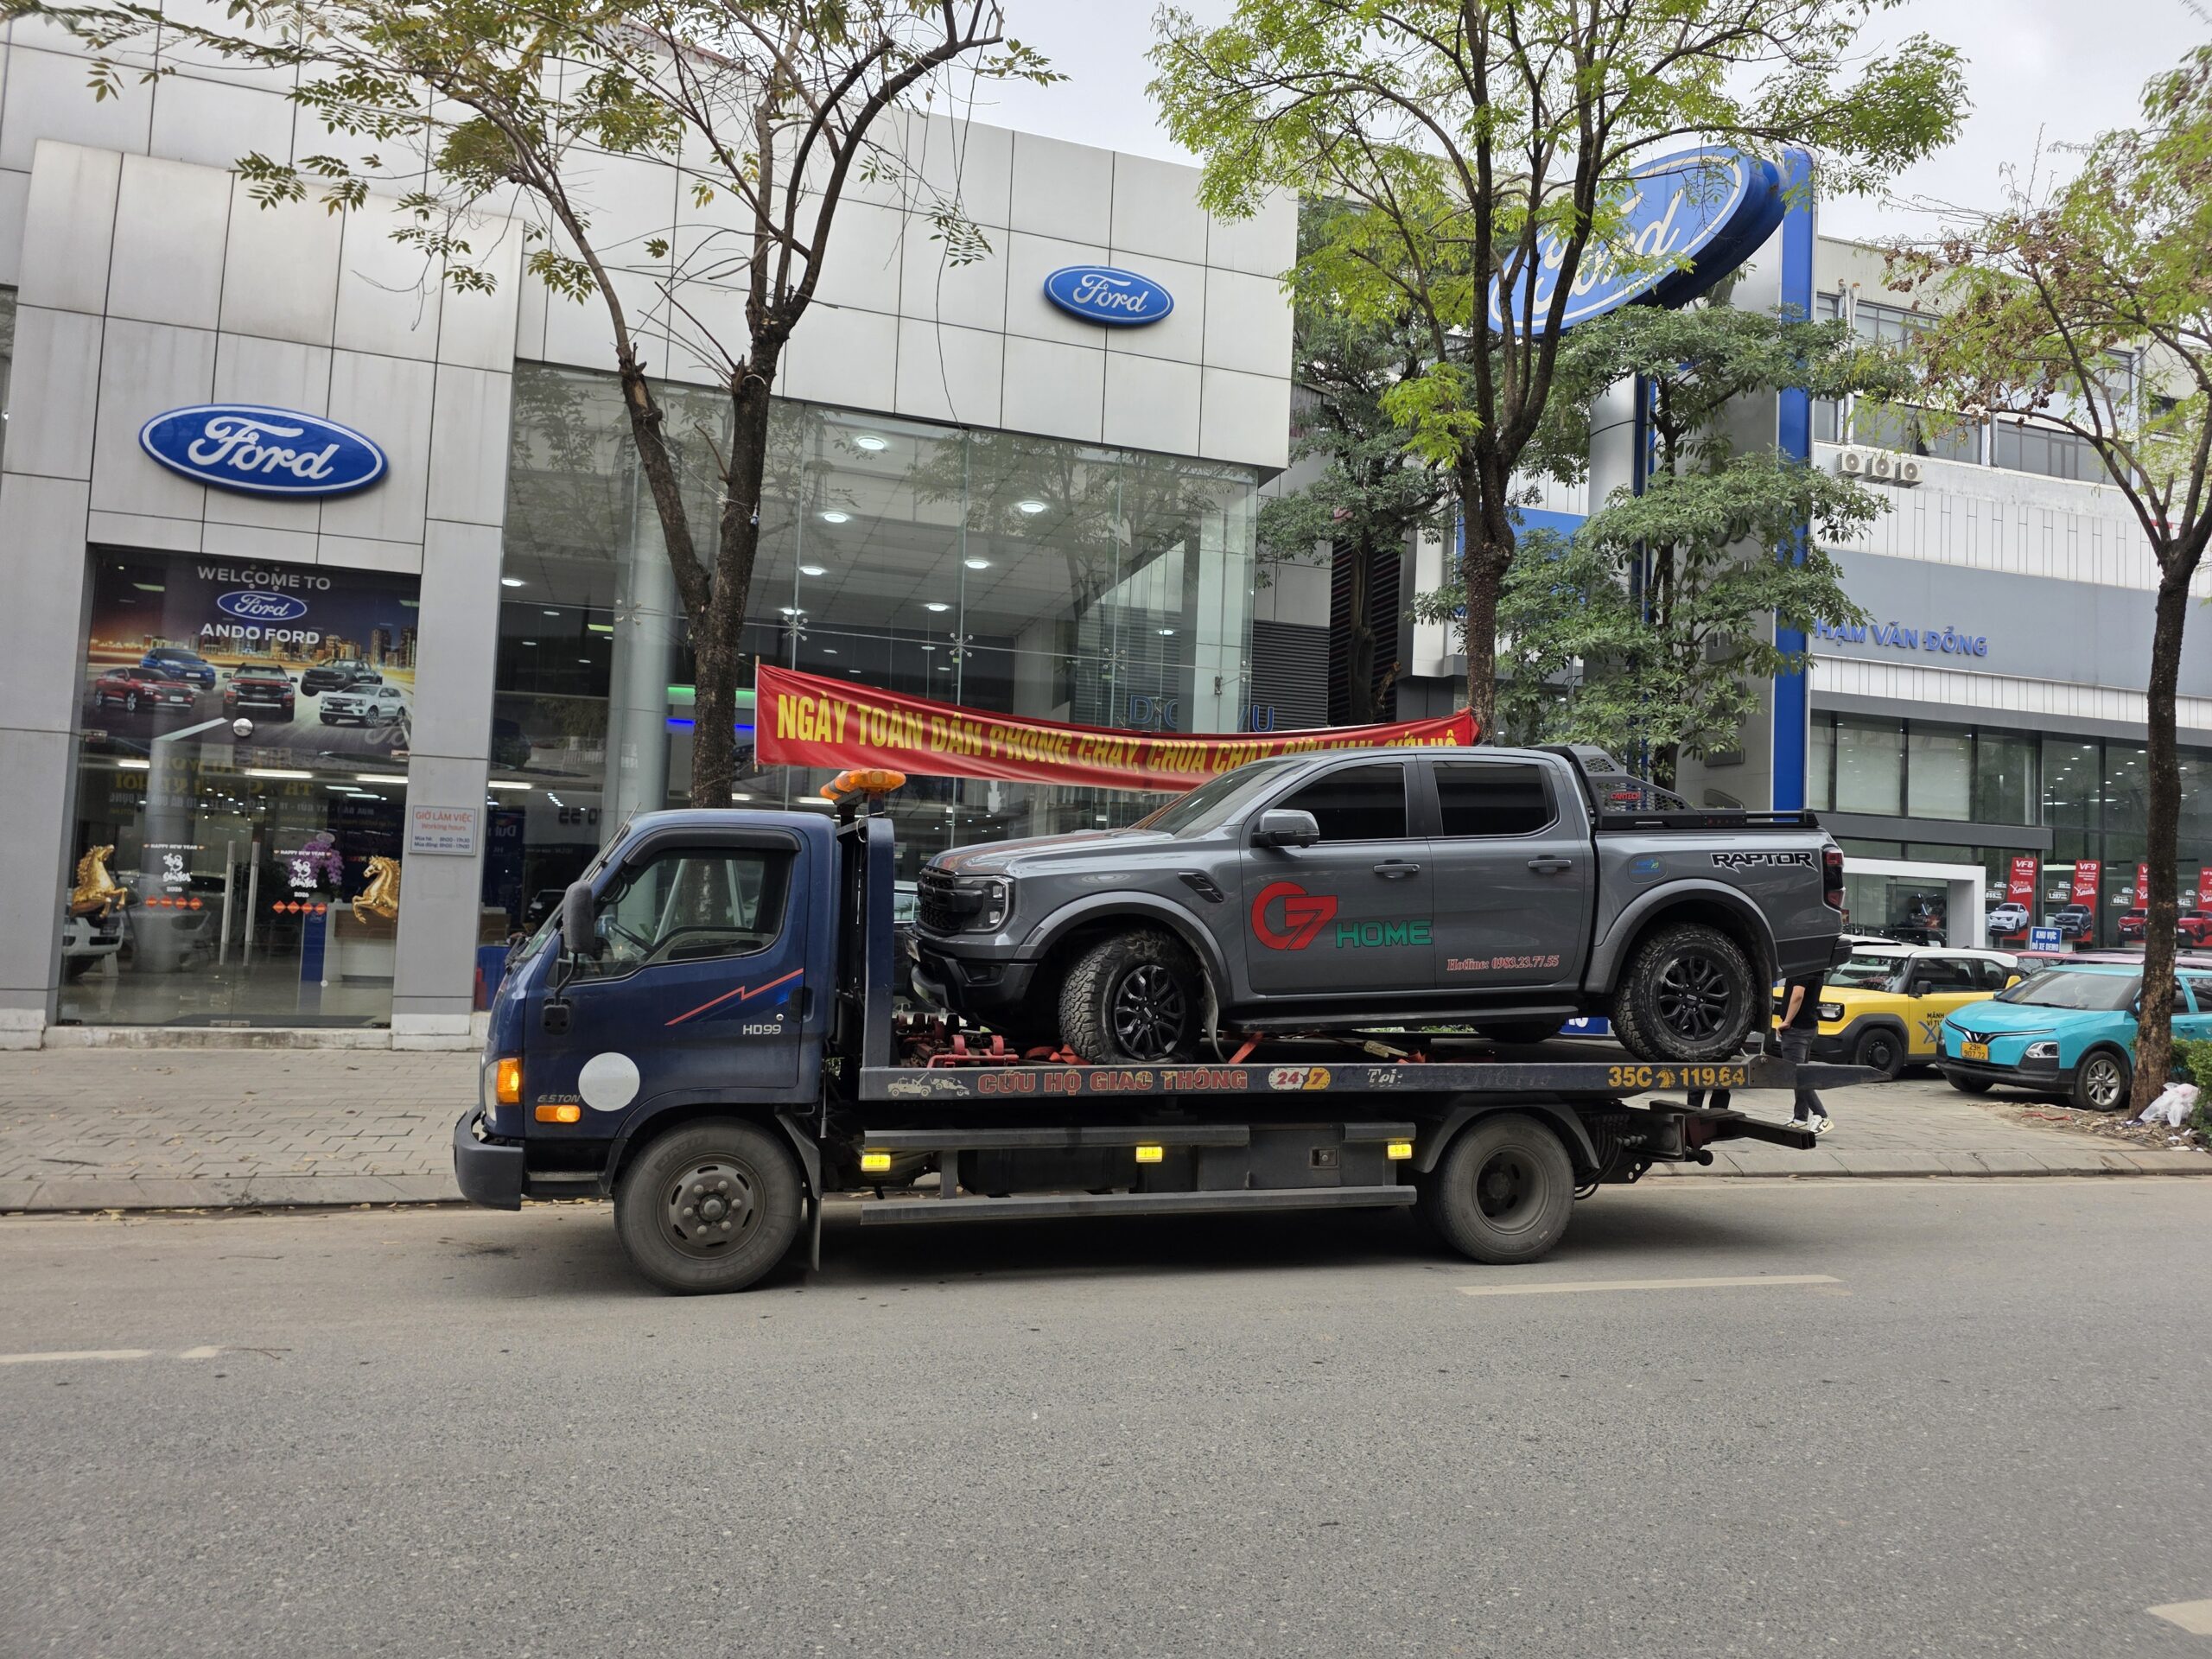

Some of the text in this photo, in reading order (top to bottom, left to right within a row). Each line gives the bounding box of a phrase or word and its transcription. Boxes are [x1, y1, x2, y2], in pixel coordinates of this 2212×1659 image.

[1073, 274, 1148, 312] Ford
[188, 416, 340, 480] Ford
[197, 566, 331, 590] WELCOME TO
[234, 594, 290, 617] Ford
[200, 623, 320, 645] ANDO FORD
[1872, 621, 1918, 649] VĂN
[777, 690, 849, 744] NGÀY
[856, 702, 924, 751] TOÀN
[931, 712, 983, 756] DÂN
[416, 810, 473, 823] GIỜ LÀM VIỆC
[422, 823, 447, 831] Working
[1710, 851, 1819, 874] RAPTOR
[1335, 919, 1433, 949] HOME
[1446, 958, 1490, 971] Hotline:
[742, 1024, 781, 1035] HD99
[1963, 1050, 1986, 1059] 907.72
[1160, 1066, 1248, 1090] THÔNG
[1608, 1065, 1653, 1088] 35C
